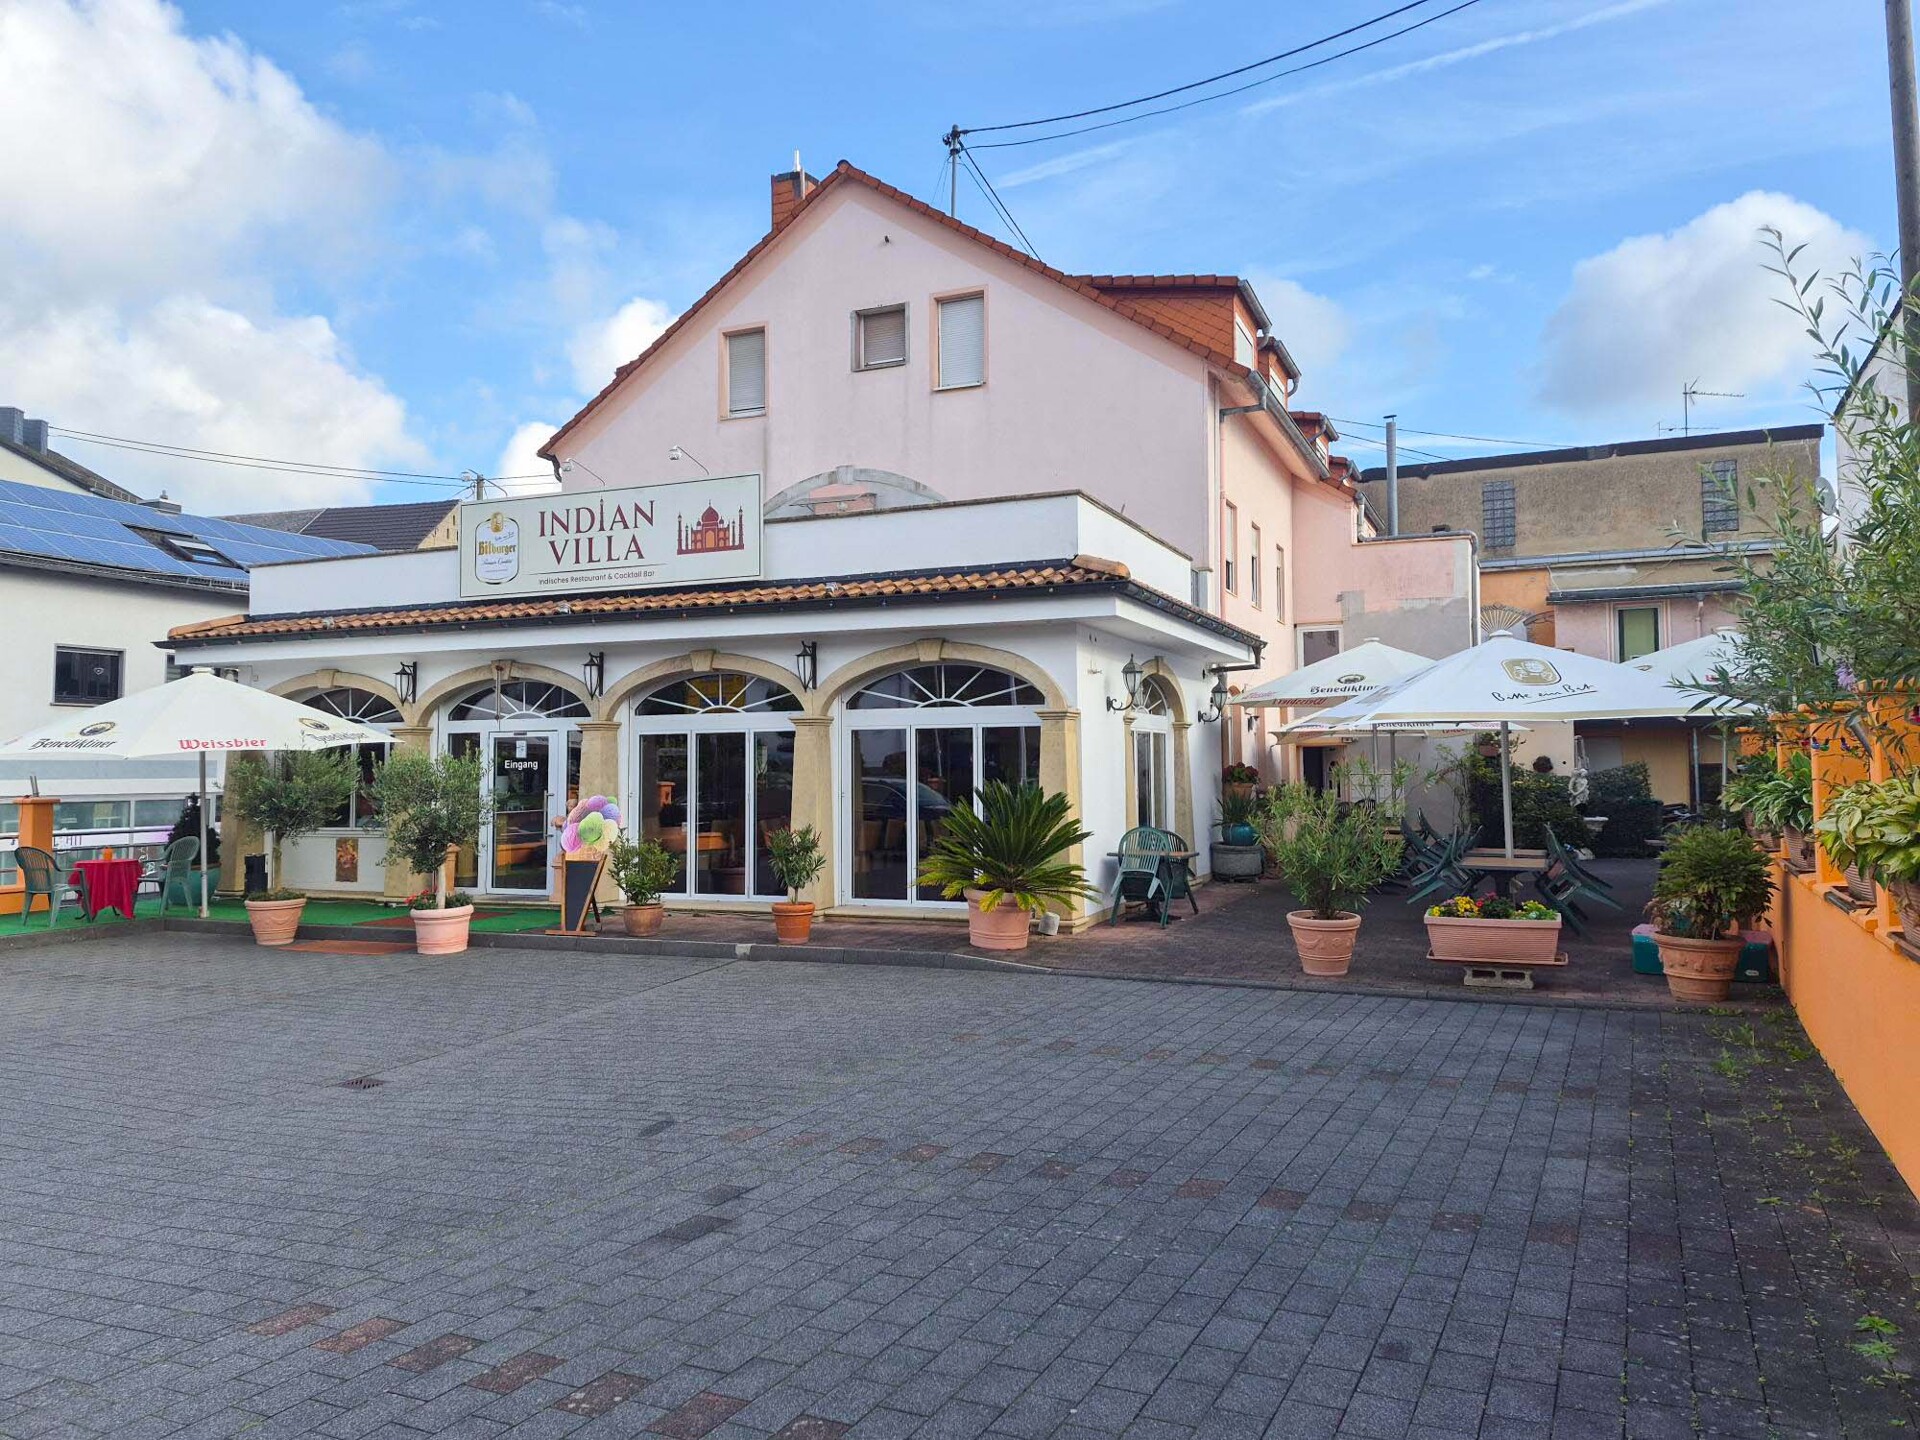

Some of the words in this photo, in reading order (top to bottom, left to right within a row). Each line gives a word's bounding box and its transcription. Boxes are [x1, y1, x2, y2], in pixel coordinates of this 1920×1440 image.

[538, 495, 656, 537] INDIAN
[548, 533, 645, 566] VILLA
[570, 574, 607, 583] Restaurant
[614, 571, 642, 579] Cocktail
[28, 738, 118, 750] Benediktiner
[178, 738, 268, 750] Weissbier
[504, 760, 539, 771] Eingang
